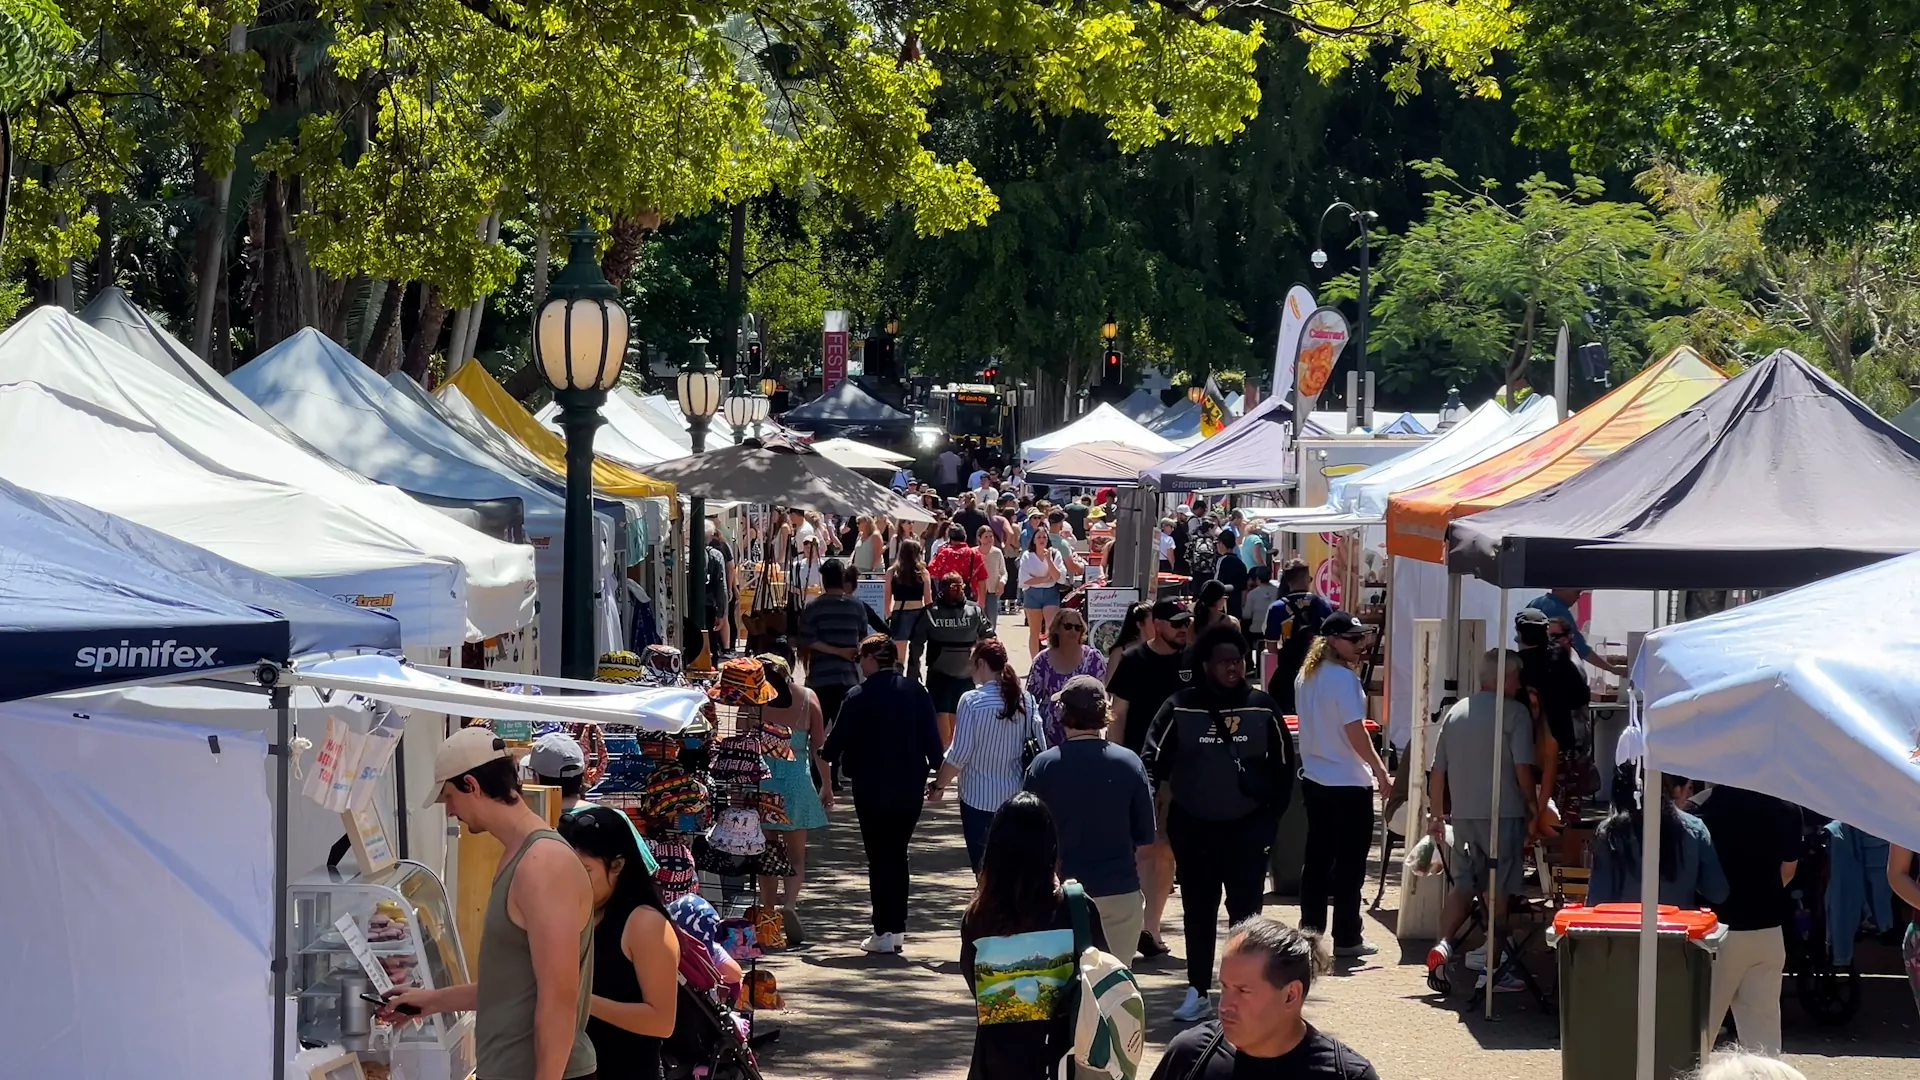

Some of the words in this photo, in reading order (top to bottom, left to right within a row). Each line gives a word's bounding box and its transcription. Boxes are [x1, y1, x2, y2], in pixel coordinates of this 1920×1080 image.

[1309, 328, 1345, 340] Calamari
[1090, 590, 1119, 602] Fresh
[935, 617, 971, 628] EVERLAST
[74, 639, 218, 673] spinifex
[1199, 736, 1216, 744] new
